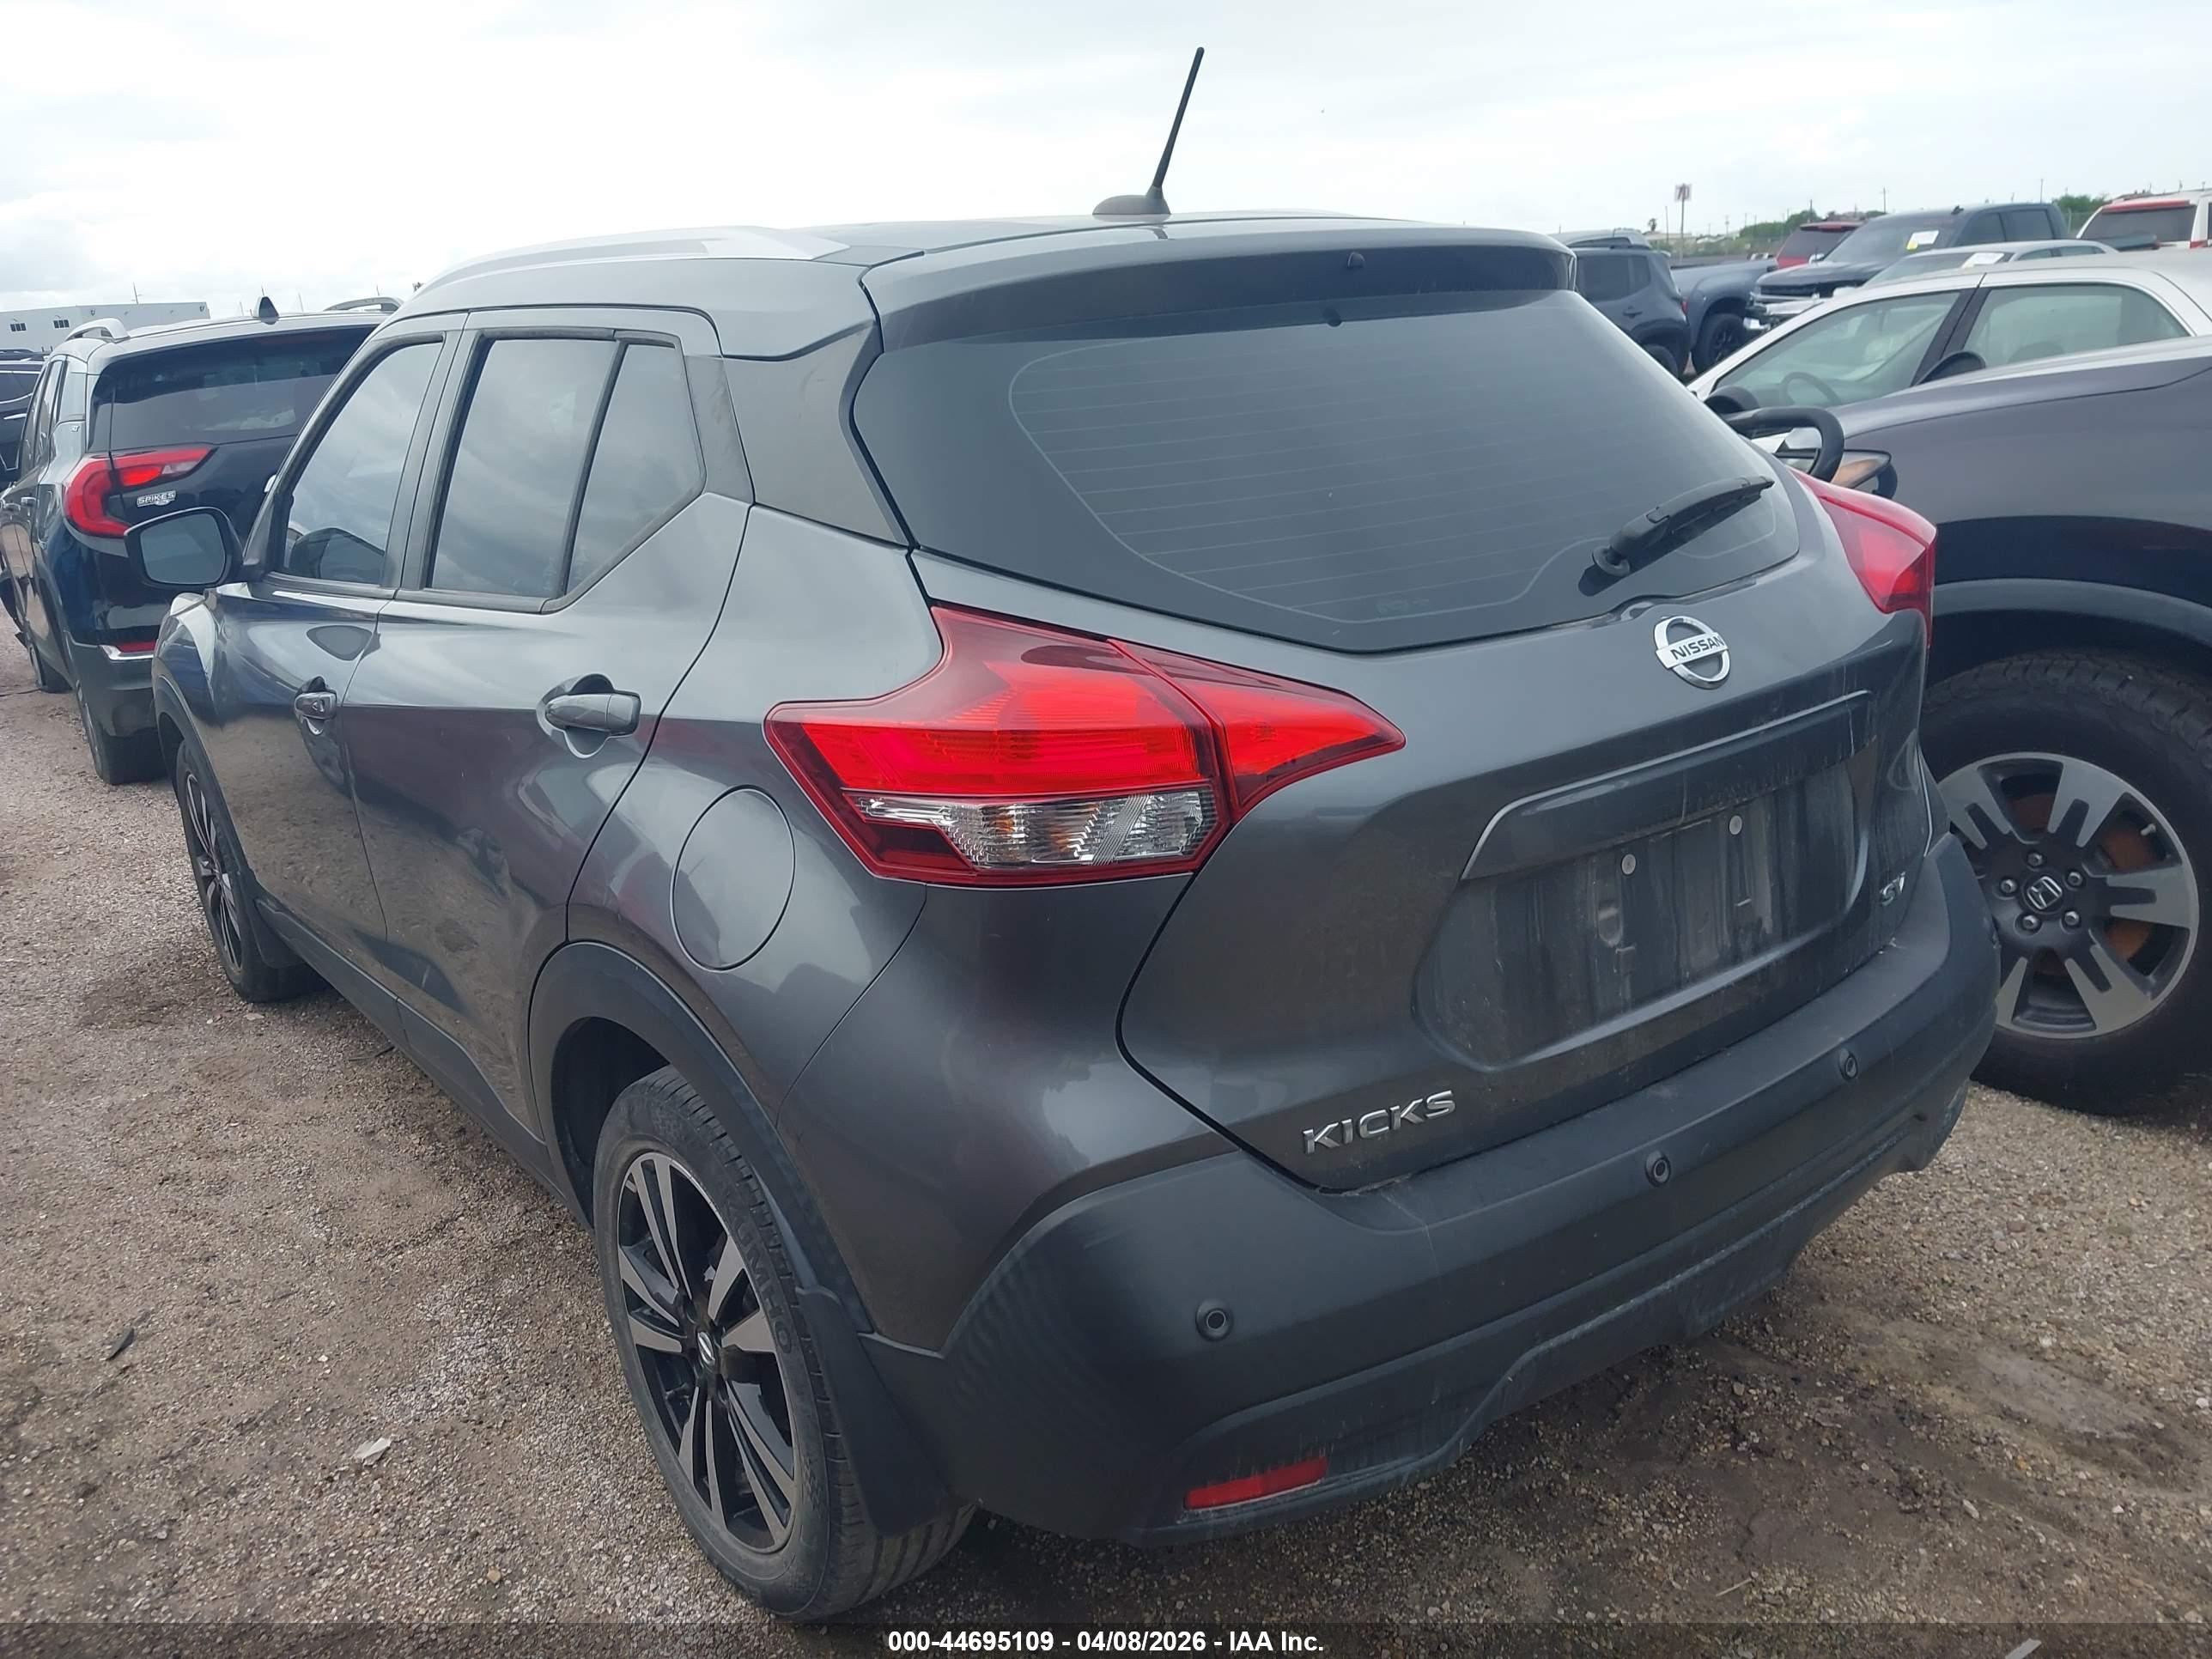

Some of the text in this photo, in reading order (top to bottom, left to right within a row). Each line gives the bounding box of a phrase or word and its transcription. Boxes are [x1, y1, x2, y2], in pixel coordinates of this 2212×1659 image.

[137, 491, 176, 506] SPIKES
[1669, 635, 1726, 660] NISSAN
[1879, 871, 1906, 907] SV
[1302, 1089, 1456, 1155] KICKS
